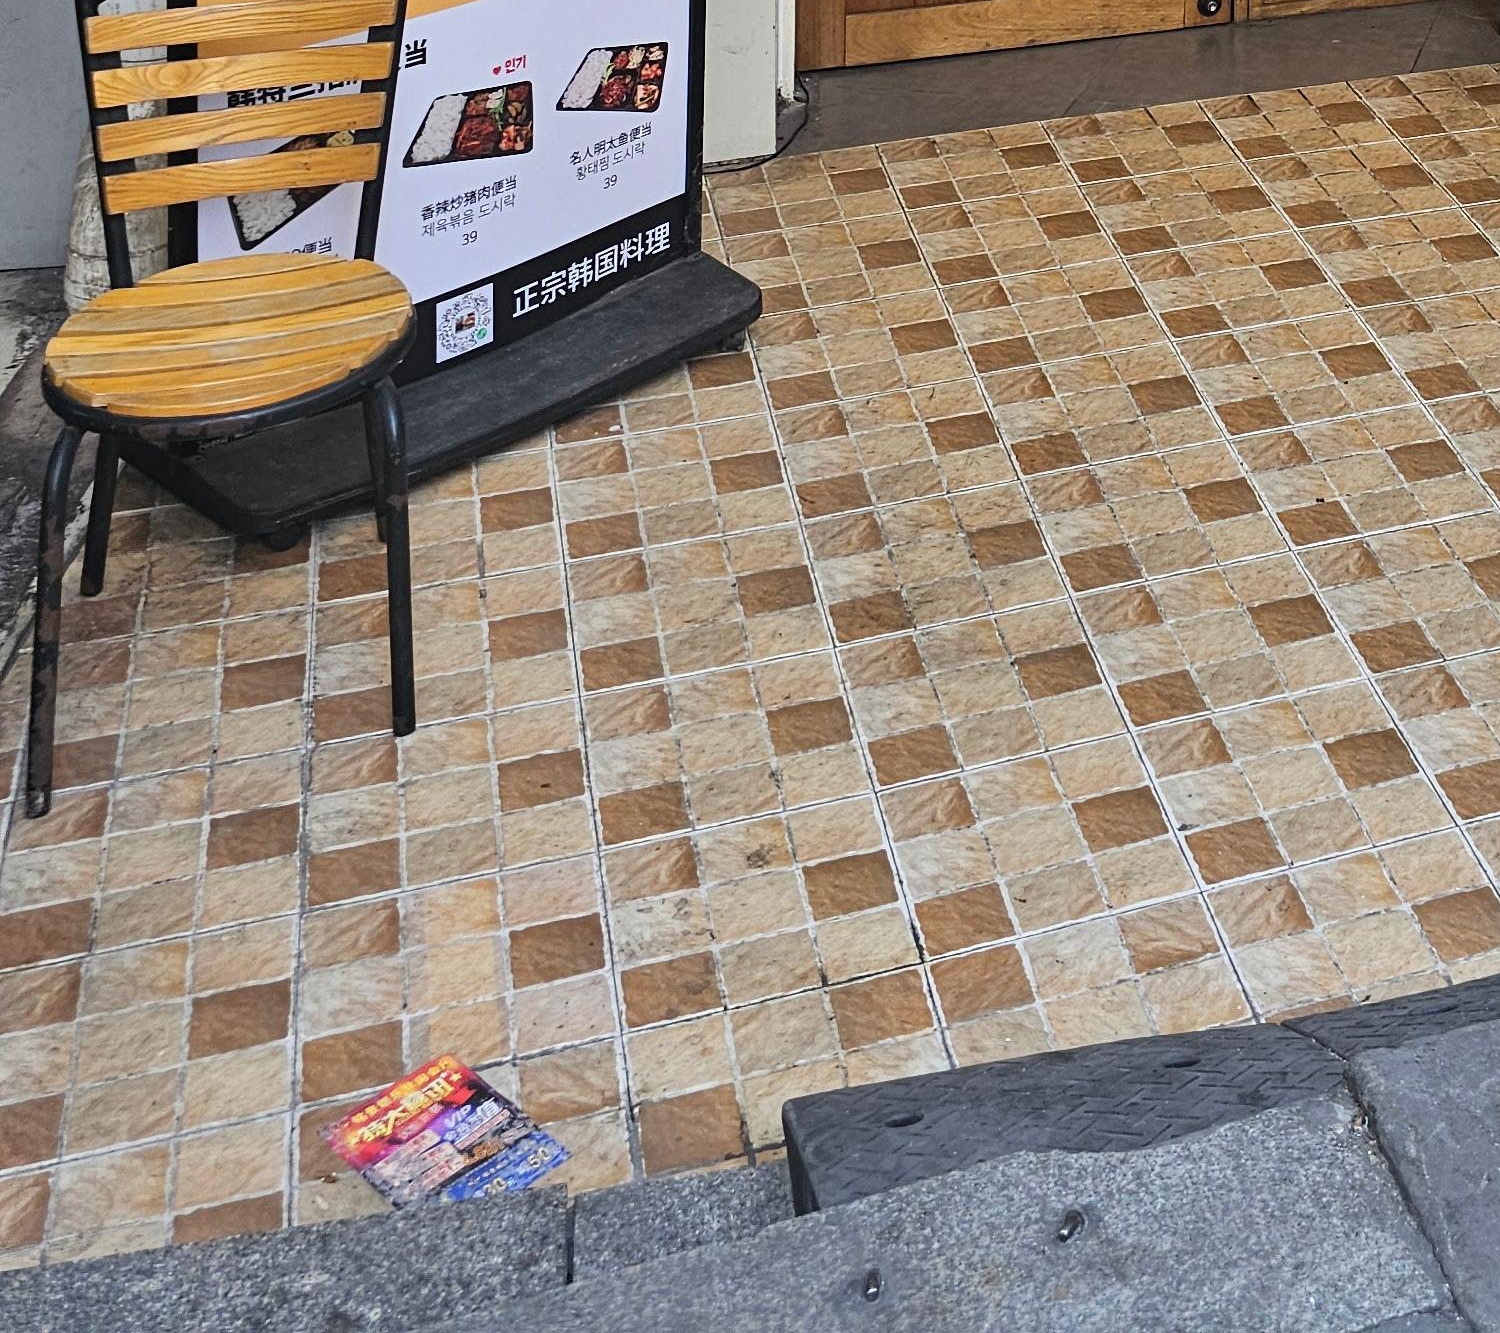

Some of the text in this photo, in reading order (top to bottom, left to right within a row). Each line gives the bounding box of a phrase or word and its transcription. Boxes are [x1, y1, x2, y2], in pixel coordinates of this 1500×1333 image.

[505, 54, 527, 74] 인기
[569, 121, 651, 165] 名人明太鱼便当
[612, 141, 645, 165] 도시락
[421, 175, 517, 221] 香辣炒猪肉便当
[603, 174, 617, 189] 39
[421, 193, 516, 238] 제육볶음 도시락
[462, 230, 478, 246] 39
[512, 221, 671, 318] 正宗韩国料理
